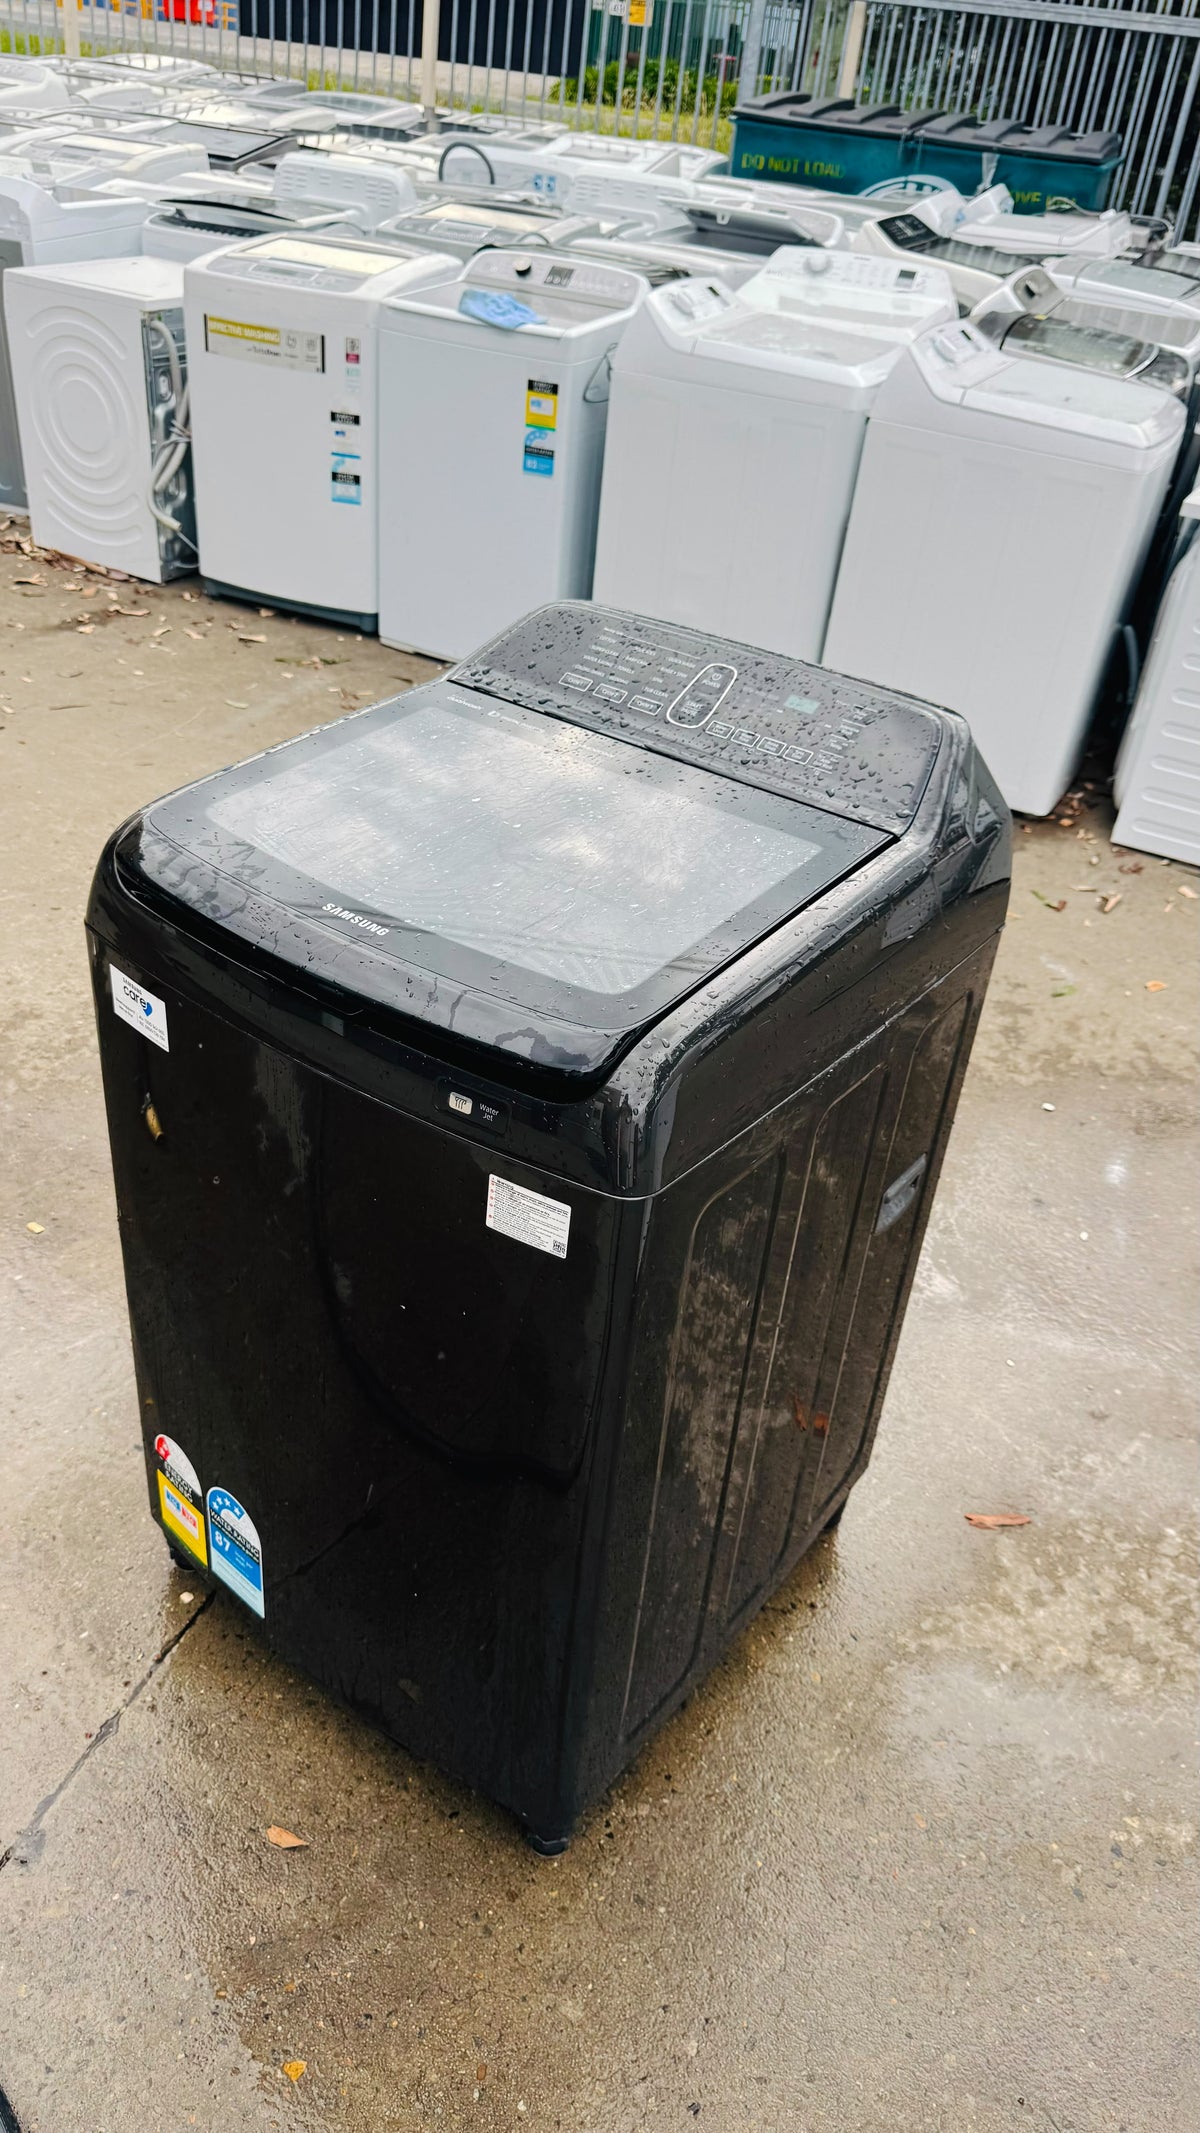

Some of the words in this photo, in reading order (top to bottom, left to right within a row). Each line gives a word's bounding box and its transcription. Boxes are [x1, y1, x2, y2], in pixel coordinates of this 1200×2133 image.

[741, 152, 765, 170] DO
[767, 155, 799, 174] NOT
[653, 690, 669, 698] CLEAN
[702, 679, 721, 689] POWER
[687, 700, 705, 709] START
[322, 903, 390, 936] SAMSUNG
[122, 976, 144, 995] SAMSUNG
[123, 985, 147, 1009] care
[479, 1103, 499, 1116] Water
[482, 1113, 493, 1122] Jet
[165, 1471, 193, 1504] RATING
[209, 1508, 234, 1533] WATER
[233, 1528, 260, 1559] RATING
[214, 1530, 231, 1552] 87
